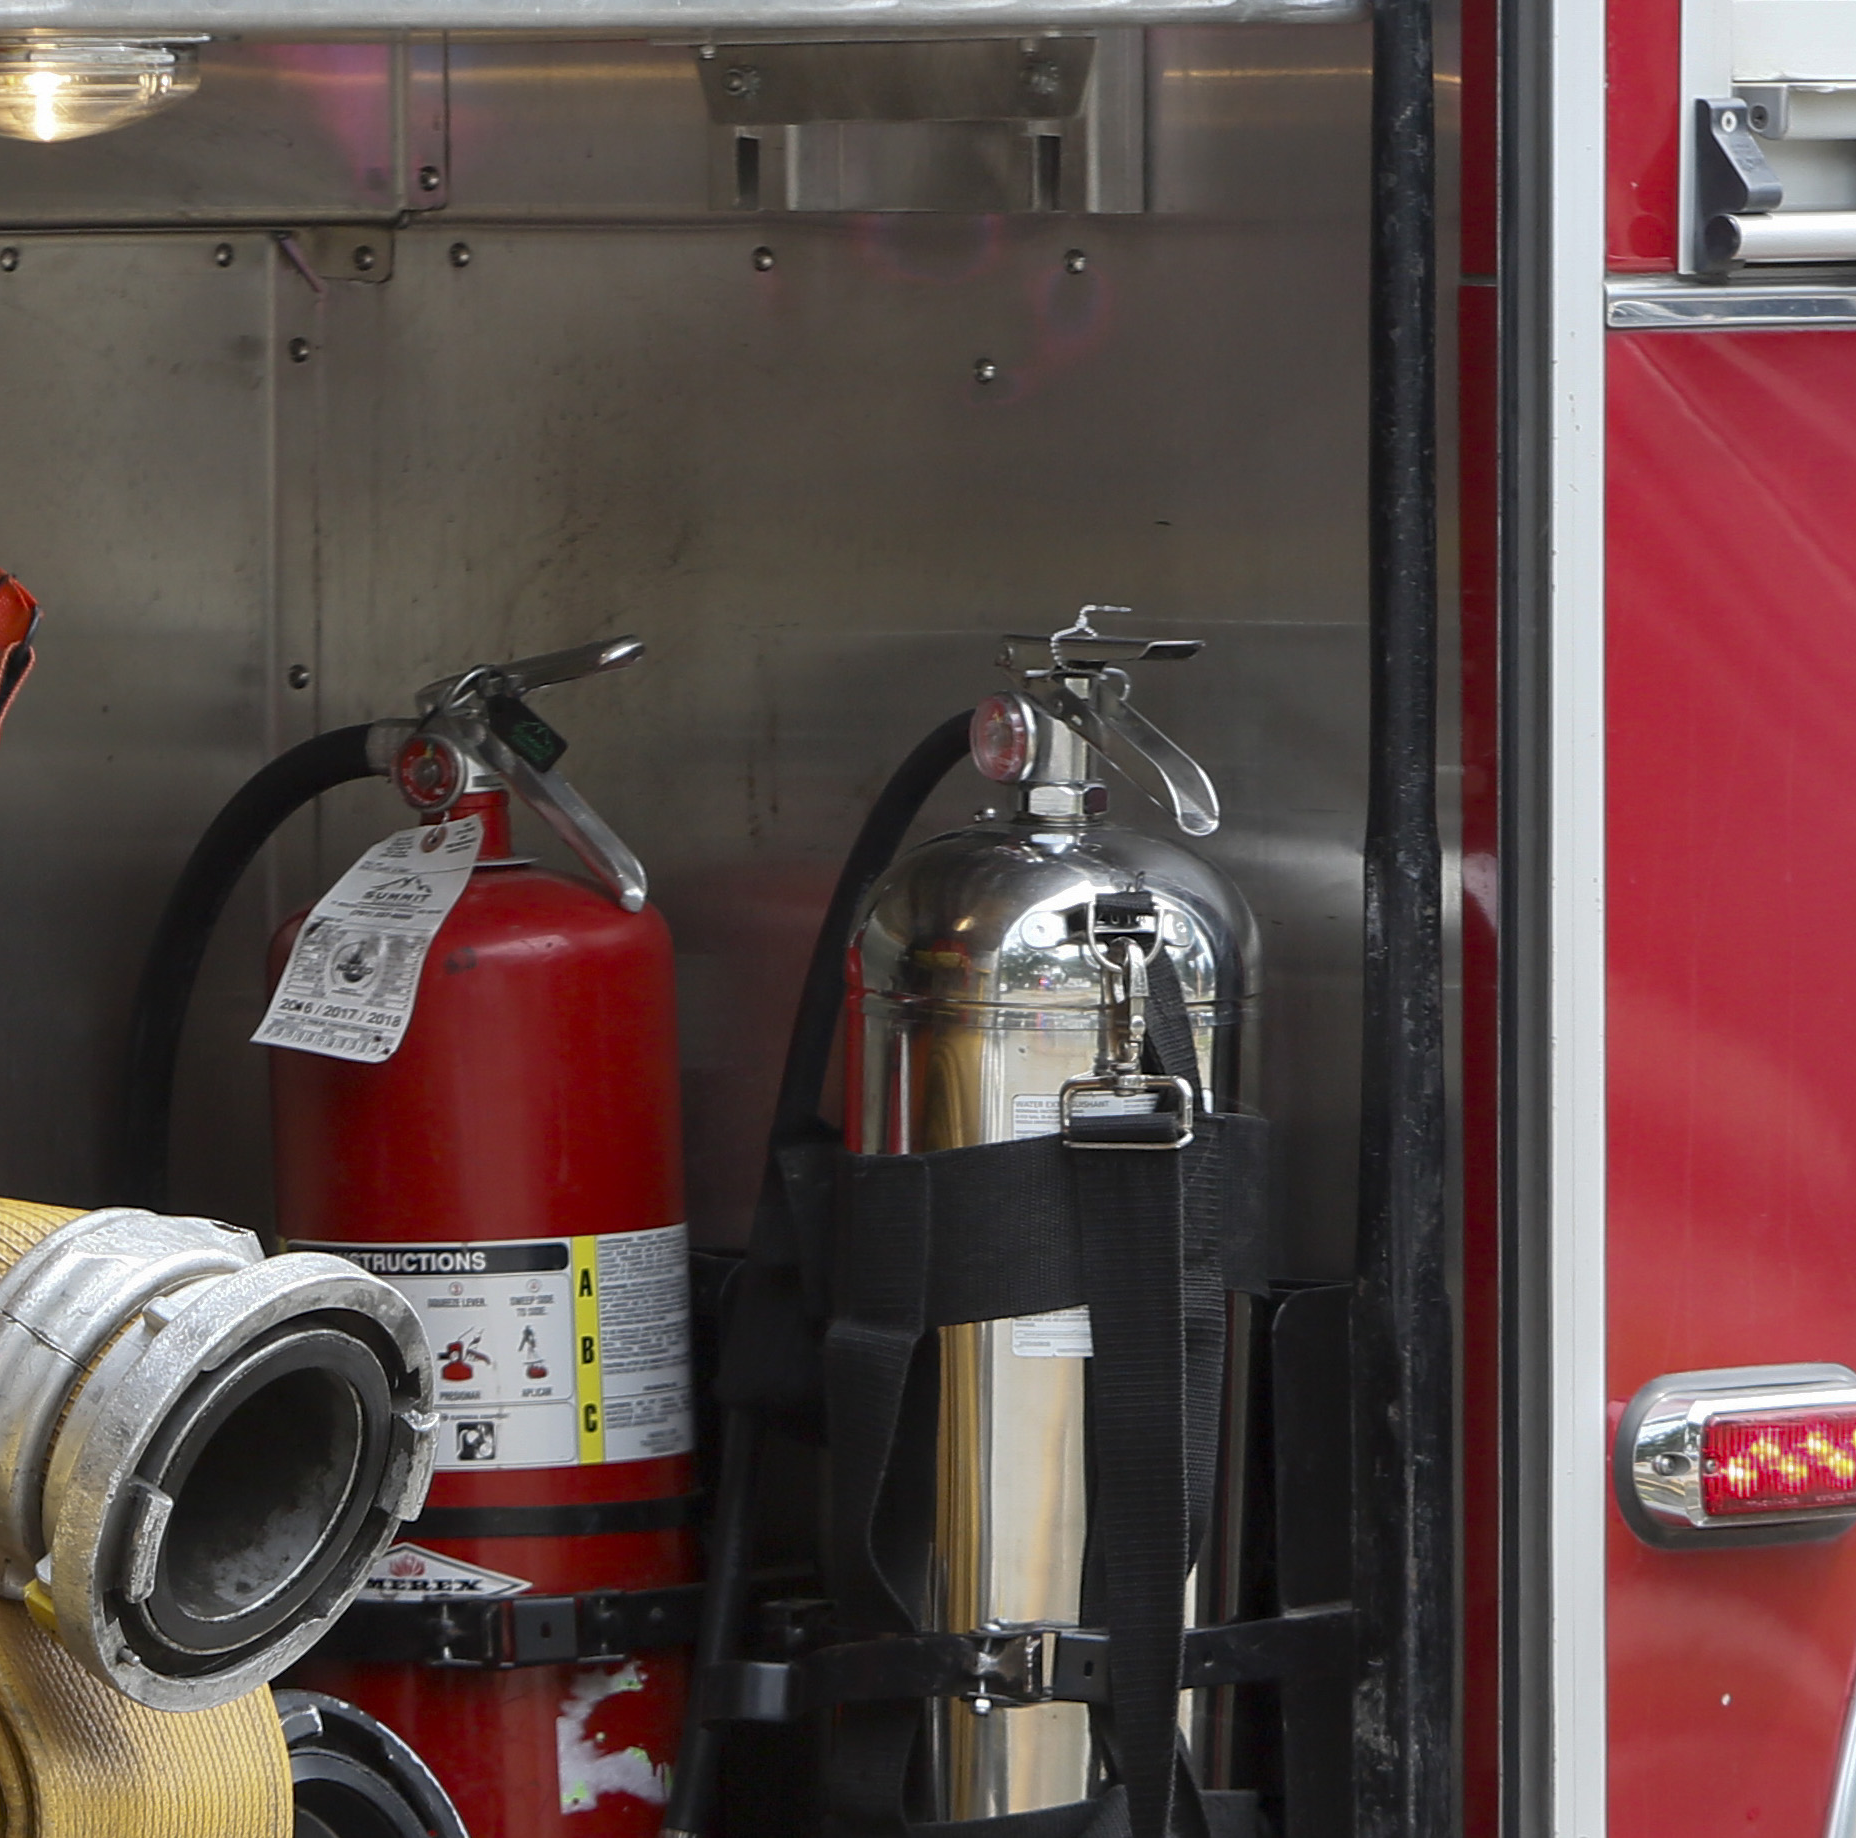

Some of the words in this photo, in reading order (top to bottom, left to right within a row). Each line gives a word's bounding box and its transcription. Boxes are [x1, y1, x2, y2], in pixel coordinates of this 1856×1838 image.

[363, 890, 432, 902] SUMMIT
[323, 1004, 359, 1019] 2017
[367, 1012, 402, 1028] 2018
[345, 1252, 487, 1272] STRUCTIONS
[578, 1268, 593, 1298] A
[581, 1336, 595, 1364] B
[584, 1405, 599, 1433] C
